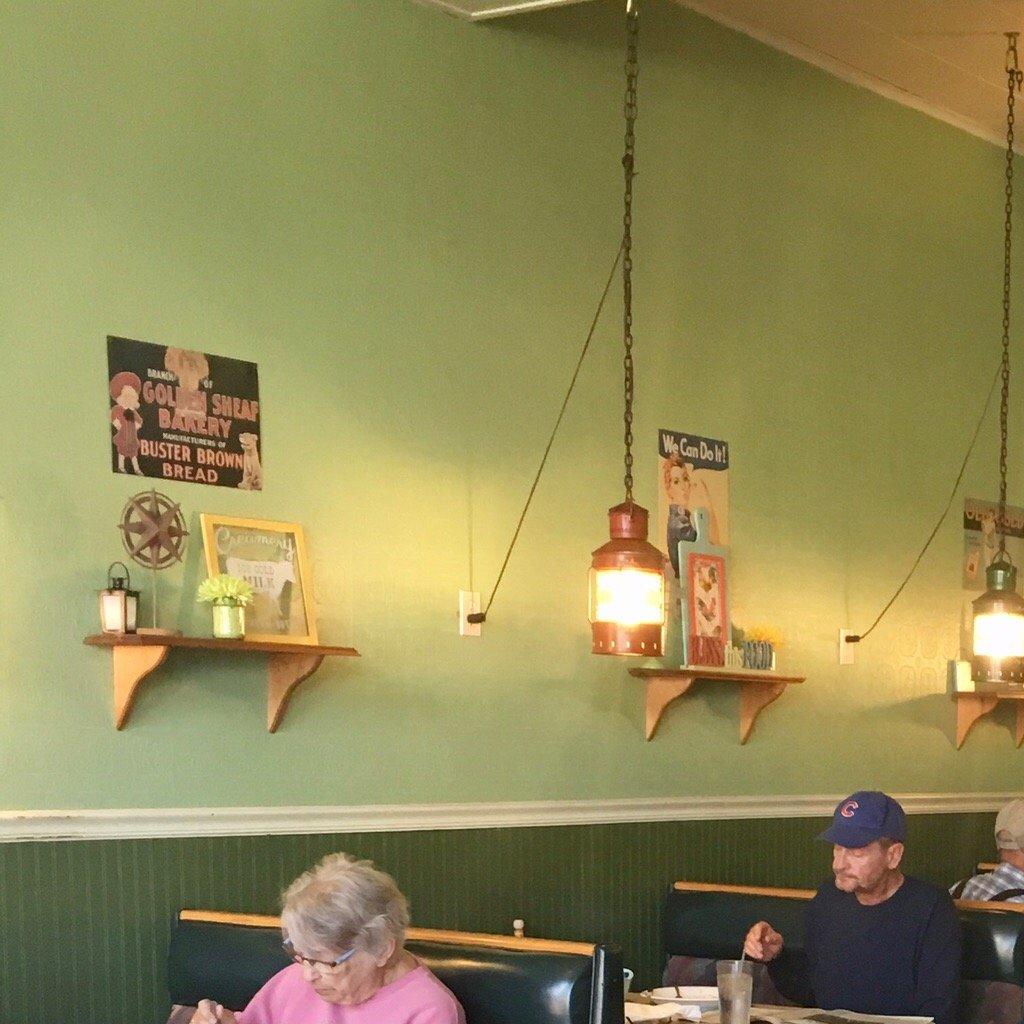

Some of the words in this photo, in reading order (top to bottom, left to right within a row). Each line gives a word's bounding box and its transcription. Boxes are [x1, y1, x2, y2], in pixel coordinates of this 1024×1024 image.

[212, 393, 259, 422] SHEAF
[158, 408, 232, 438] BAKERY
[140, 440, 191, 462] BUSTER
[197, 448, 243, 468] BROWN
[662, 433, 679, 454] We
[680, 437, 699, 459] Can
[700, 441, 714, 462] Do
[715, 444, 727, 464] It!
[162, 462, 219, 483] BREAD
[841, 800, 859, 818] C
